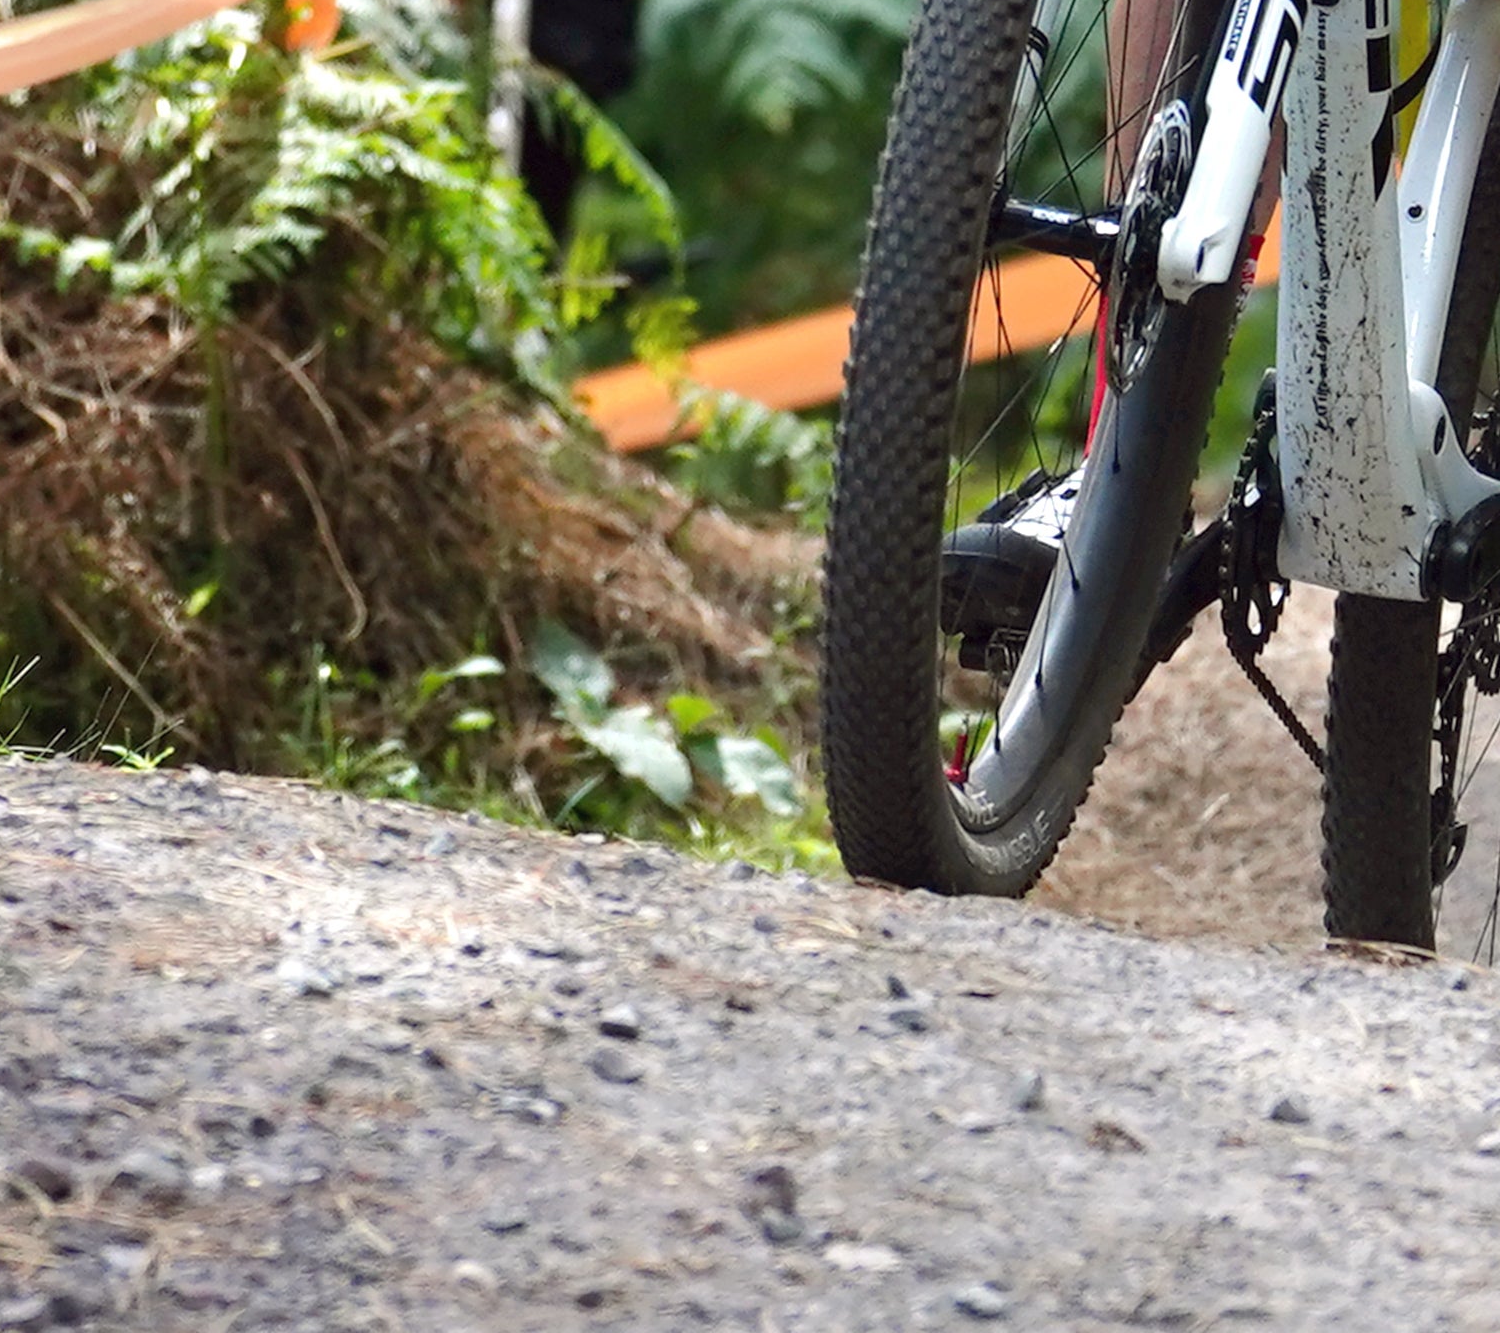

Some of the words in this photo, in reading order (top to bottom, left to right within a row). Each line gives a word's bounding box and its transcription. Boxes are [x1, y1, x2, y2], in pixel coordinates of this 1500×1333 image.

[1316, 9, 1330, 50] messy
[1313, 52, 1326, 82] hair
[1317, 85, 1331, 115] your
[1314, 117, 1330, 154] dirty,
[1315, 156, 1327, 172] be
